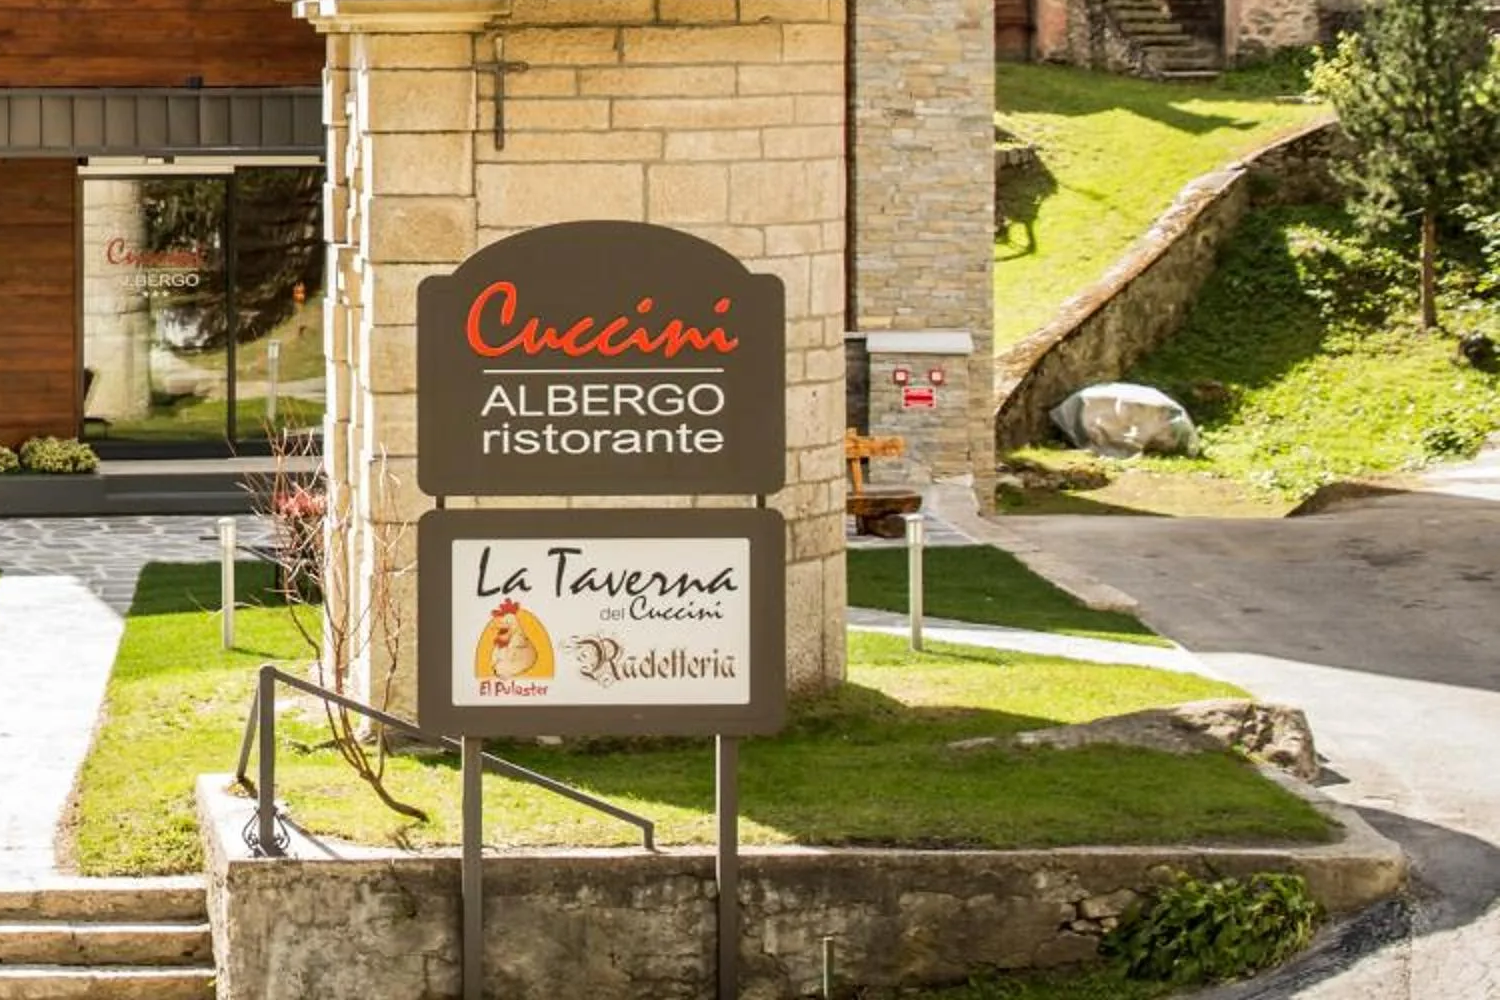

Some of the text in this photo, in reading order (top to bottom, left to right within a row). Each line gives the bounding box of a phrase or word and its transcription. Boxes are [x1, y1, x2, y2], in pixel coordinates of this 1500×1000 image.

[466, 281, 737, 357] Cuccini
[480, 382, 726, 417] ALBERGO
[482, 422, 725, 454] ristorante
[477, 546, 738, 598] La Taverna
[599, 595, 724, 621] del Cuccini
